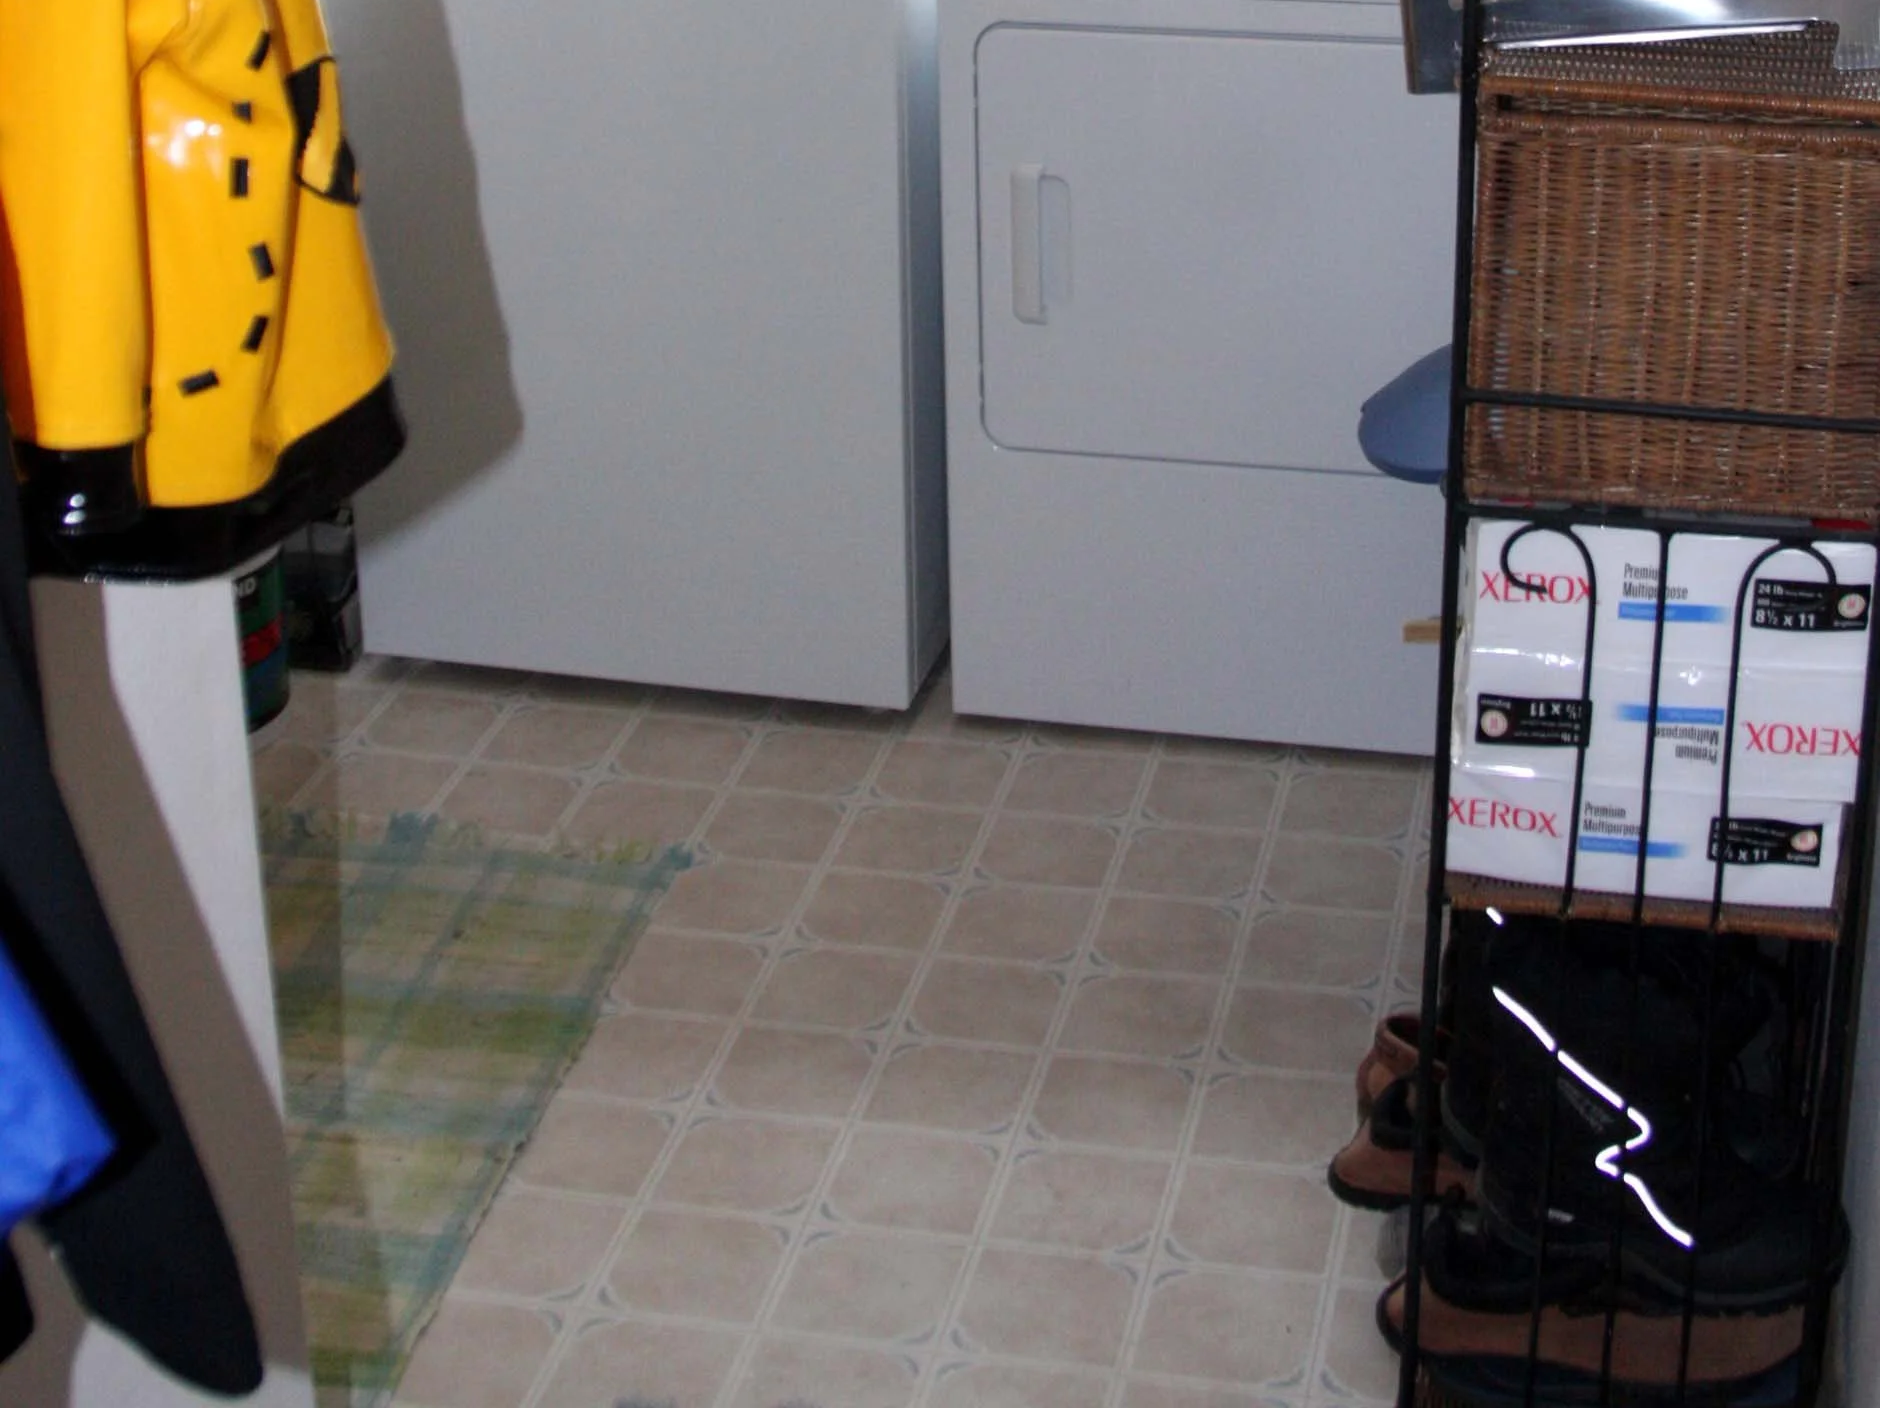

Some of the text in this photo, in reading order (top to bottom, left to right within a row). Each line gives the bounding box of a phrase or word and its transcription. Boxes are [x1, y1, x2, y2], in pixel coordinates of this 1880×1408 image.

[1623, 562, 1660, 580] Premiu
[1783, 615, 1793, 626] x
[1799, 613, 1815, 628] 11
[1530, 702, 1545, 717] 11
[1745, 720, 1861, 755] XEROX
[1675, 744, 1717, 765] Premium
[1446, 796, 1558, 838] XEROX
[1584, 800, 1626, 818] Premium
